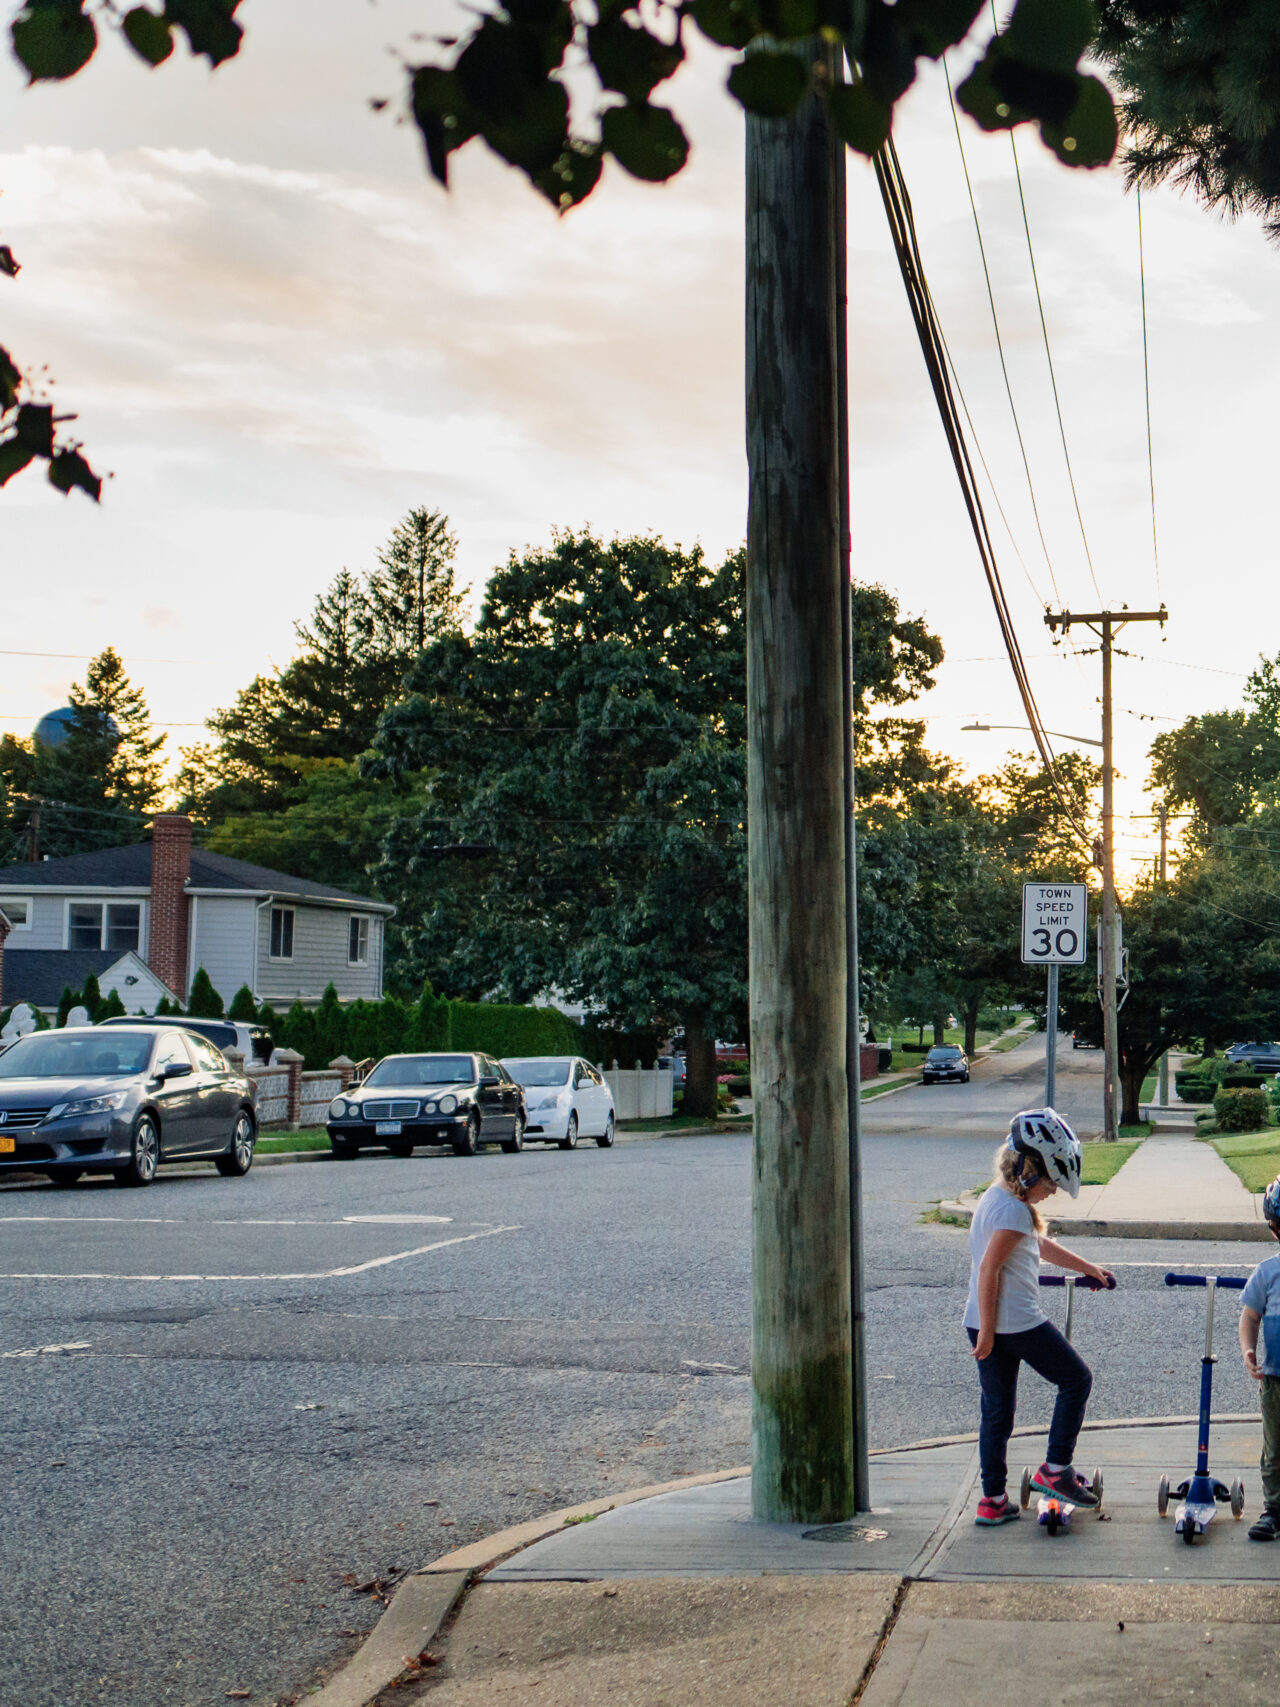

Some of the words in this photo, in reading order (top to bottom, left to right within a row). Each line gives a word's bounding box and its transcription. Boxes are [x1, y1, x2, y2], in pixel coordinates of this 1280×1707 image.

[1039, 889, 1072, 899] TOWN
[1035, 902, 1074, 912] SPEED
[1039, 916, 1070, 926] LIMIT
[1030, 928, 1078, 957] 30
